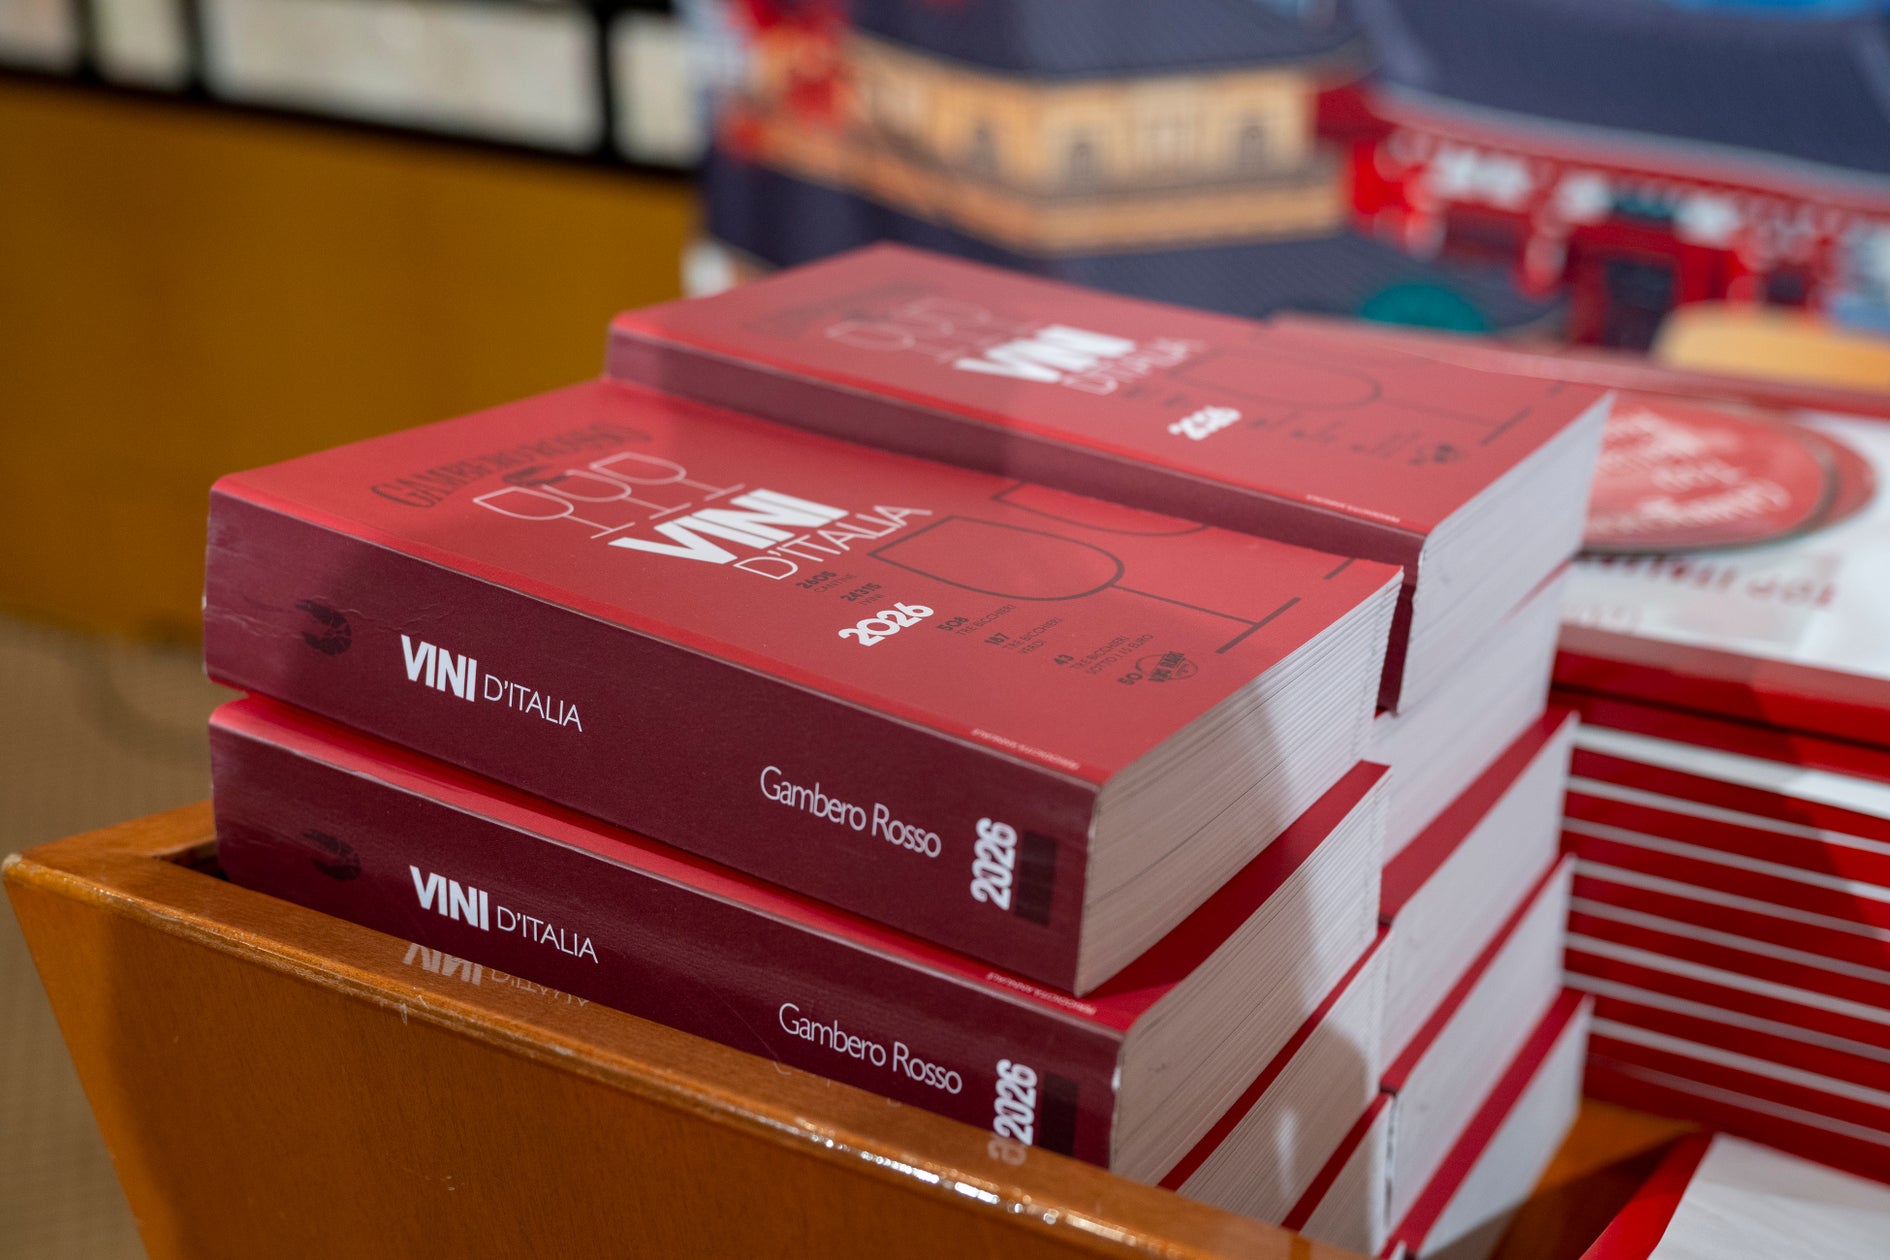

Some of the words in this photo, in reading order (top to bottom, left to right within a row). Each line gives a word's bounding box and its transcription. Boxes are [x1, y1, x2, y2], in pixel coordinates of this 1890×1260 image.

[954, 324, 1136, 384] VINI
[607, 488, 849, 565] VINI
[733, 505, 932, 580] D'ITALIA
[838, 602, 934, 647] 2026
[400, 634, 477, 701] VINI
[483, 673, 583, 733] D'ITALIA
[1117, 672, 1143, 685] 50
[760, 765, 867, 831] Gambero
[872, 803, 942, 858] Rosso
[970, 817, 1017, 911] 2026
[409, 865, 489, 931] VINI
[497, 905, 599, 964] D'ITALIA
[779, 1002, 887, 1067] Gambero
[892, 1041, 962, 1095] Rosso
[993, 1059, 1038, 1147] 2026
